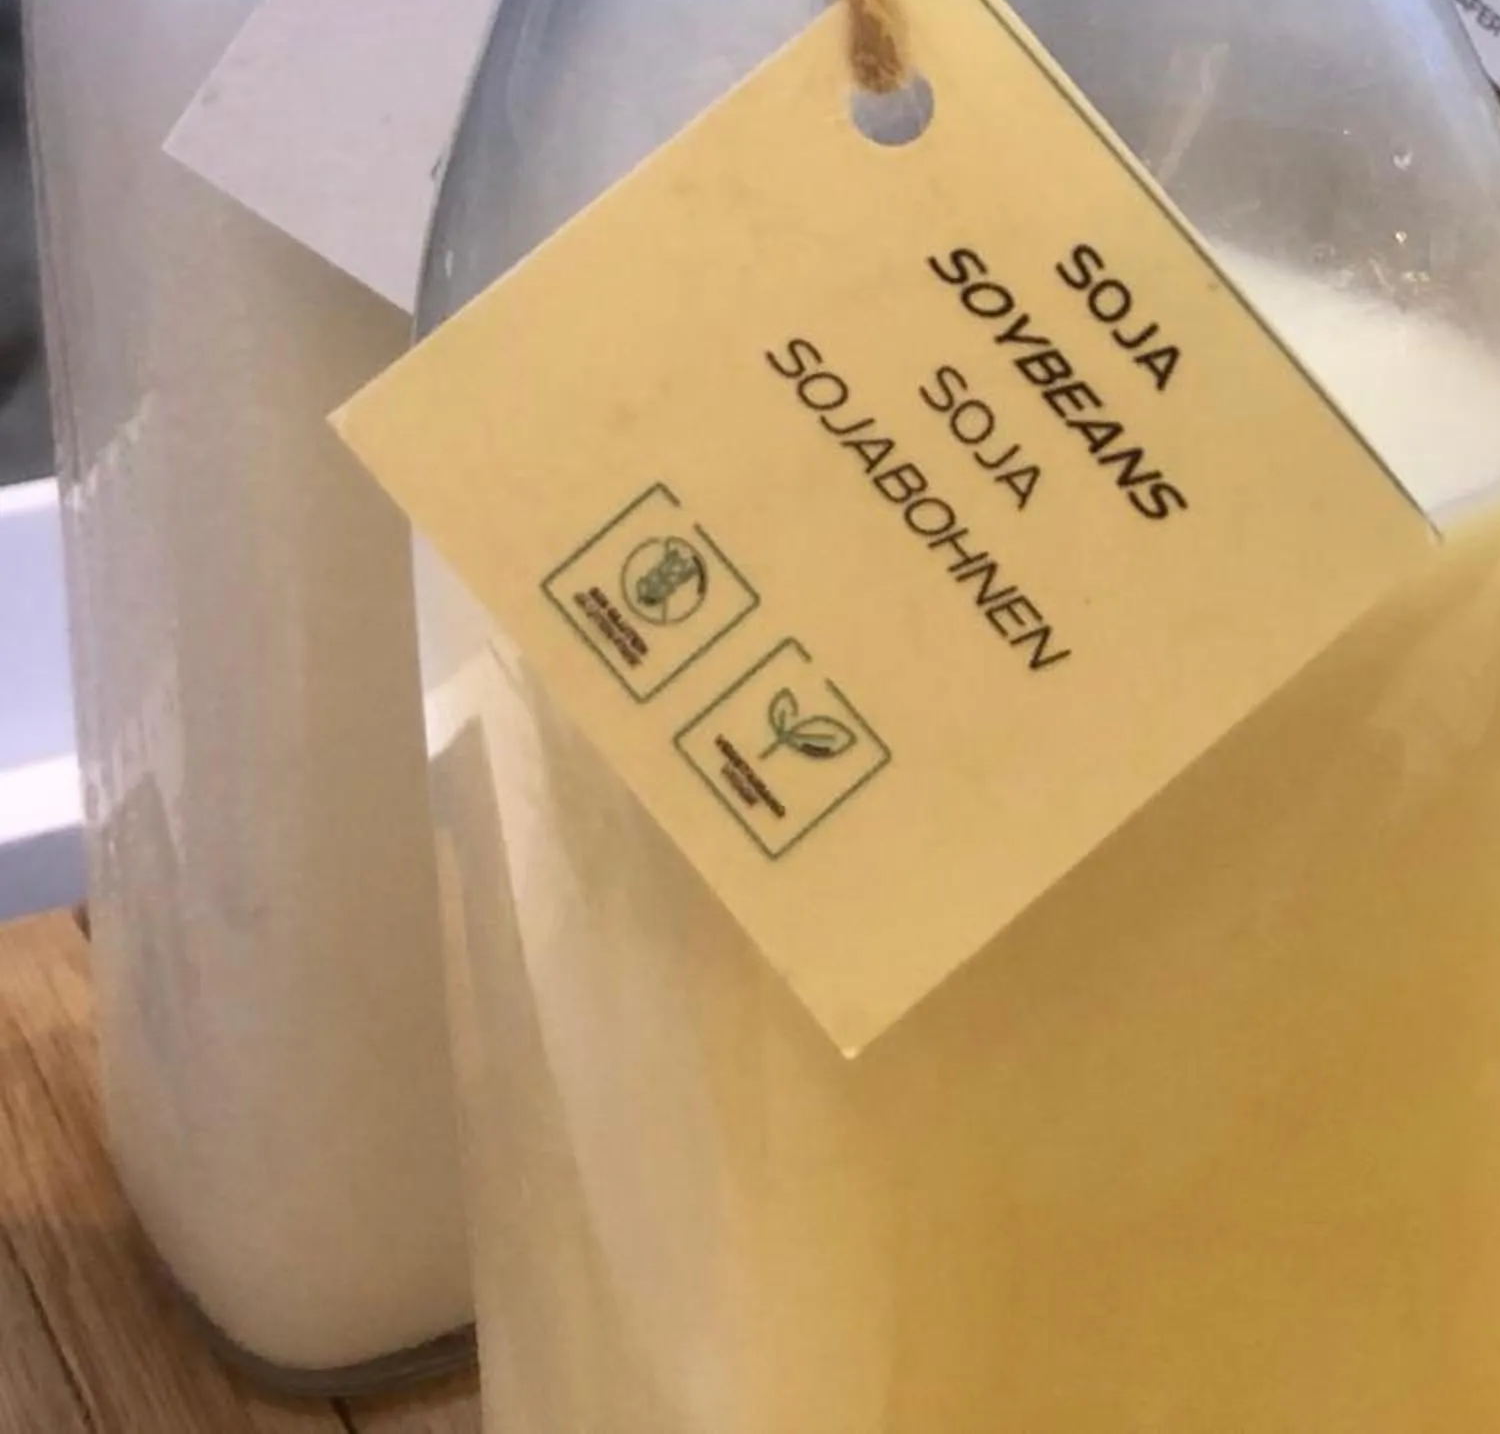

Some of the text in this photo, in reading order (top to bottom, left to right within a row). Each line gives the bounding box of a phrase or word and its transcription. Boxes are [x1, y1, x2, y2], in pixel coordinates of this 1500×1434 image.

[927, 247, 1189, 521] SOYBEANS
[1056, 243, 1182, 392] SOJA
[765, 338, 1072, 671] SOJABOHNEN
[918, 365, 1042, 511] SOJA
